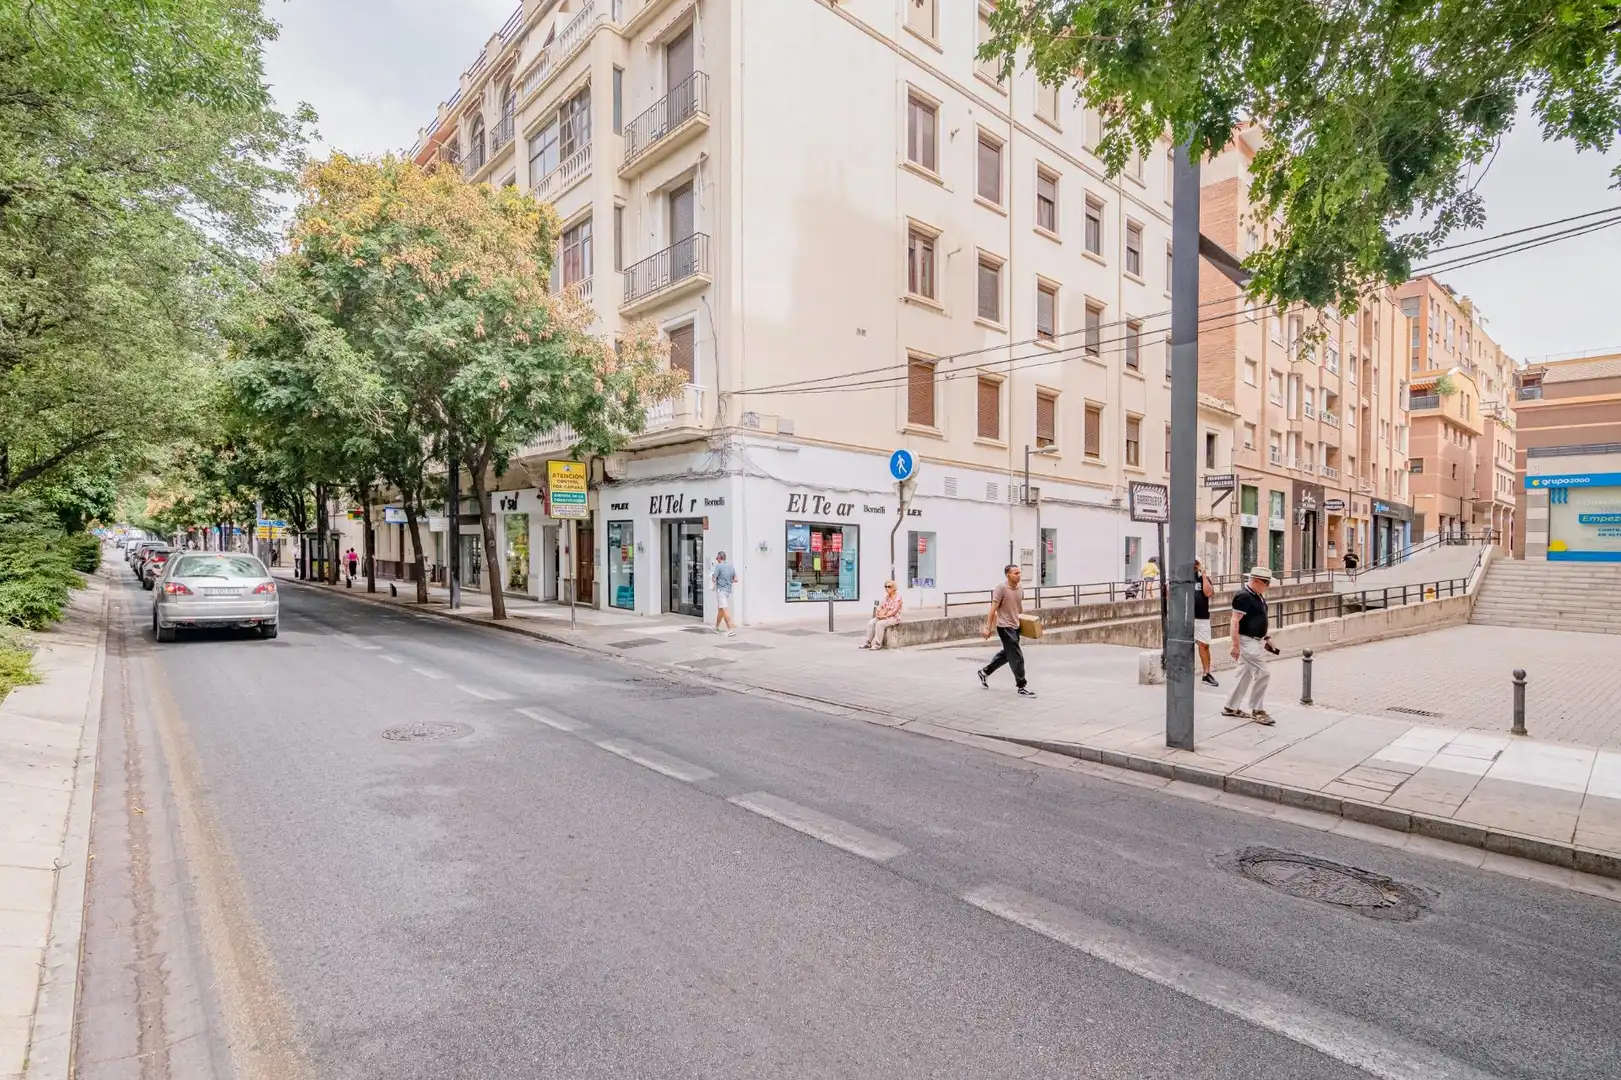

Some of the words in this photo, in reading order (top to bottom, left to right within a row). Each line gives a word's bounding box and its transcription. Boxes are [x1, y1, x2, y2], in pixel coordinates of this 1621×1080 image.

[1542, 478, 1590, 486] grupo2000
[648, 495, 662, 514] El
[786, 493, 808, 514] El
